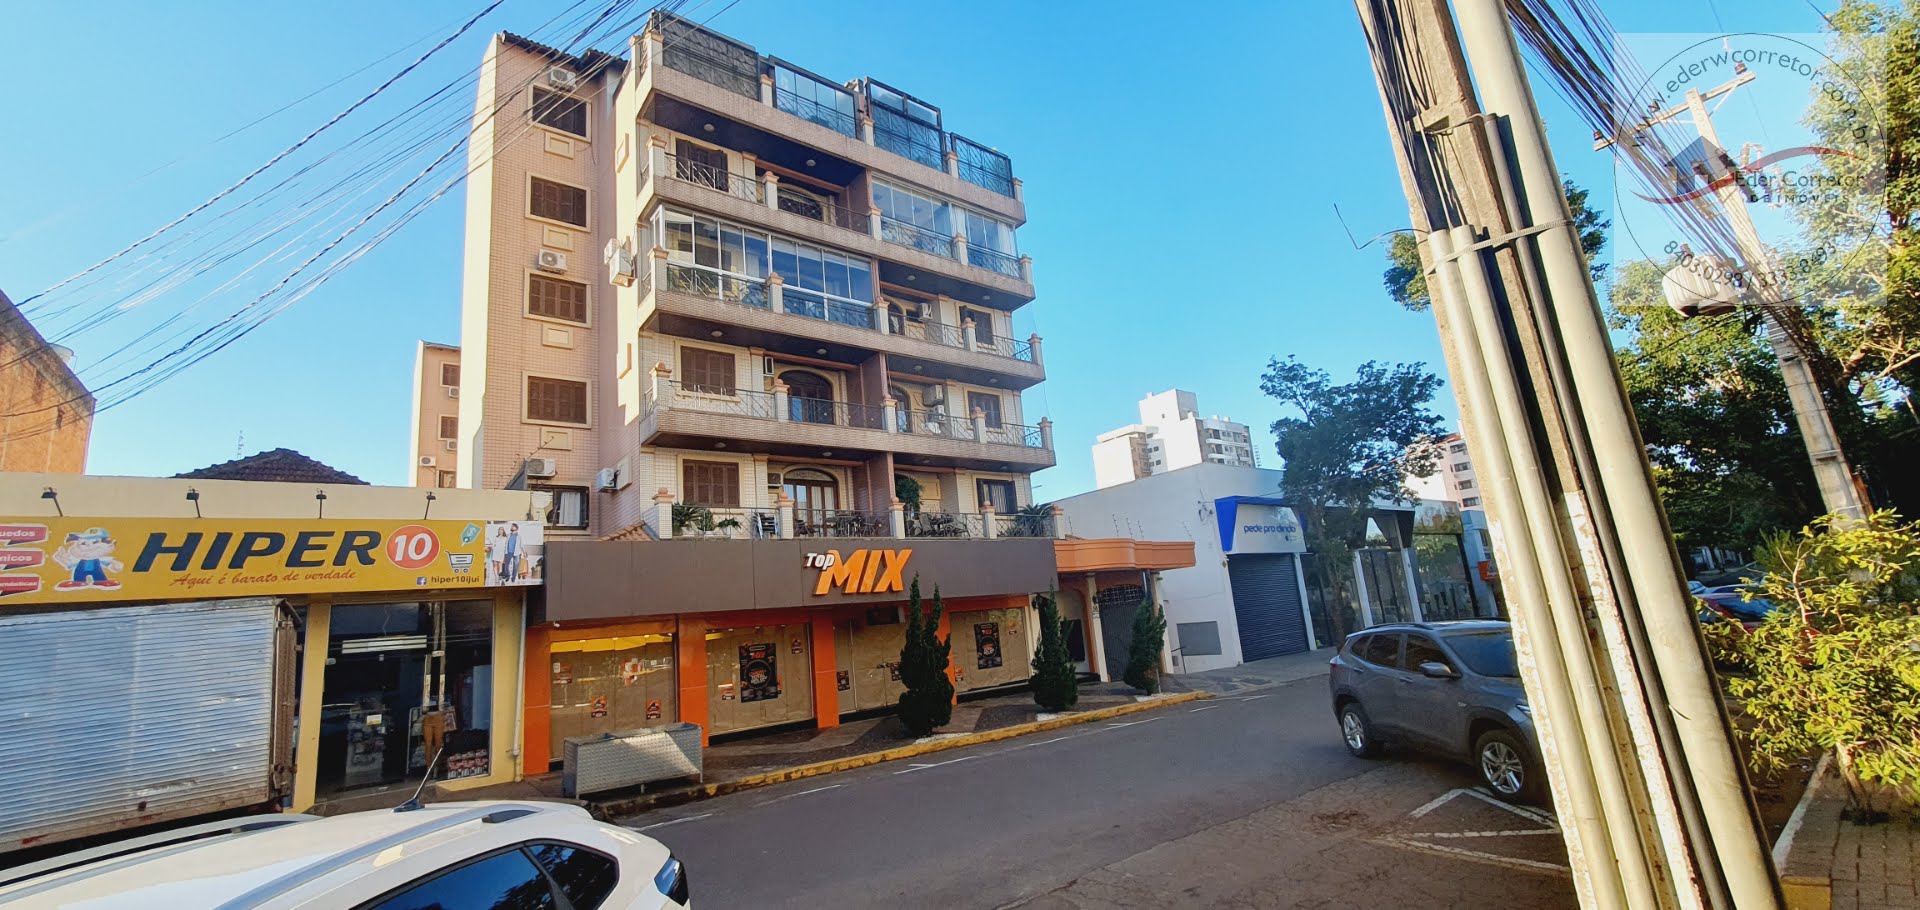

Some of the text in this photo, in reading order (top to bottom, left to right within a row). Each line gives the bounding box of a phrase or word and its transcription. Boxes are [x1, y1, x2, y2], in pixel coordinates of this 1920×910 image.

[1244, 524, 1263, 534] pede
[1264, 525, 1276, 534] pro
[132, 530, 433, 573] HIPER 10
[169, 568, 357, 589] Aqui é barato de verdade
[804, 548, 913, 595] Top MIX
